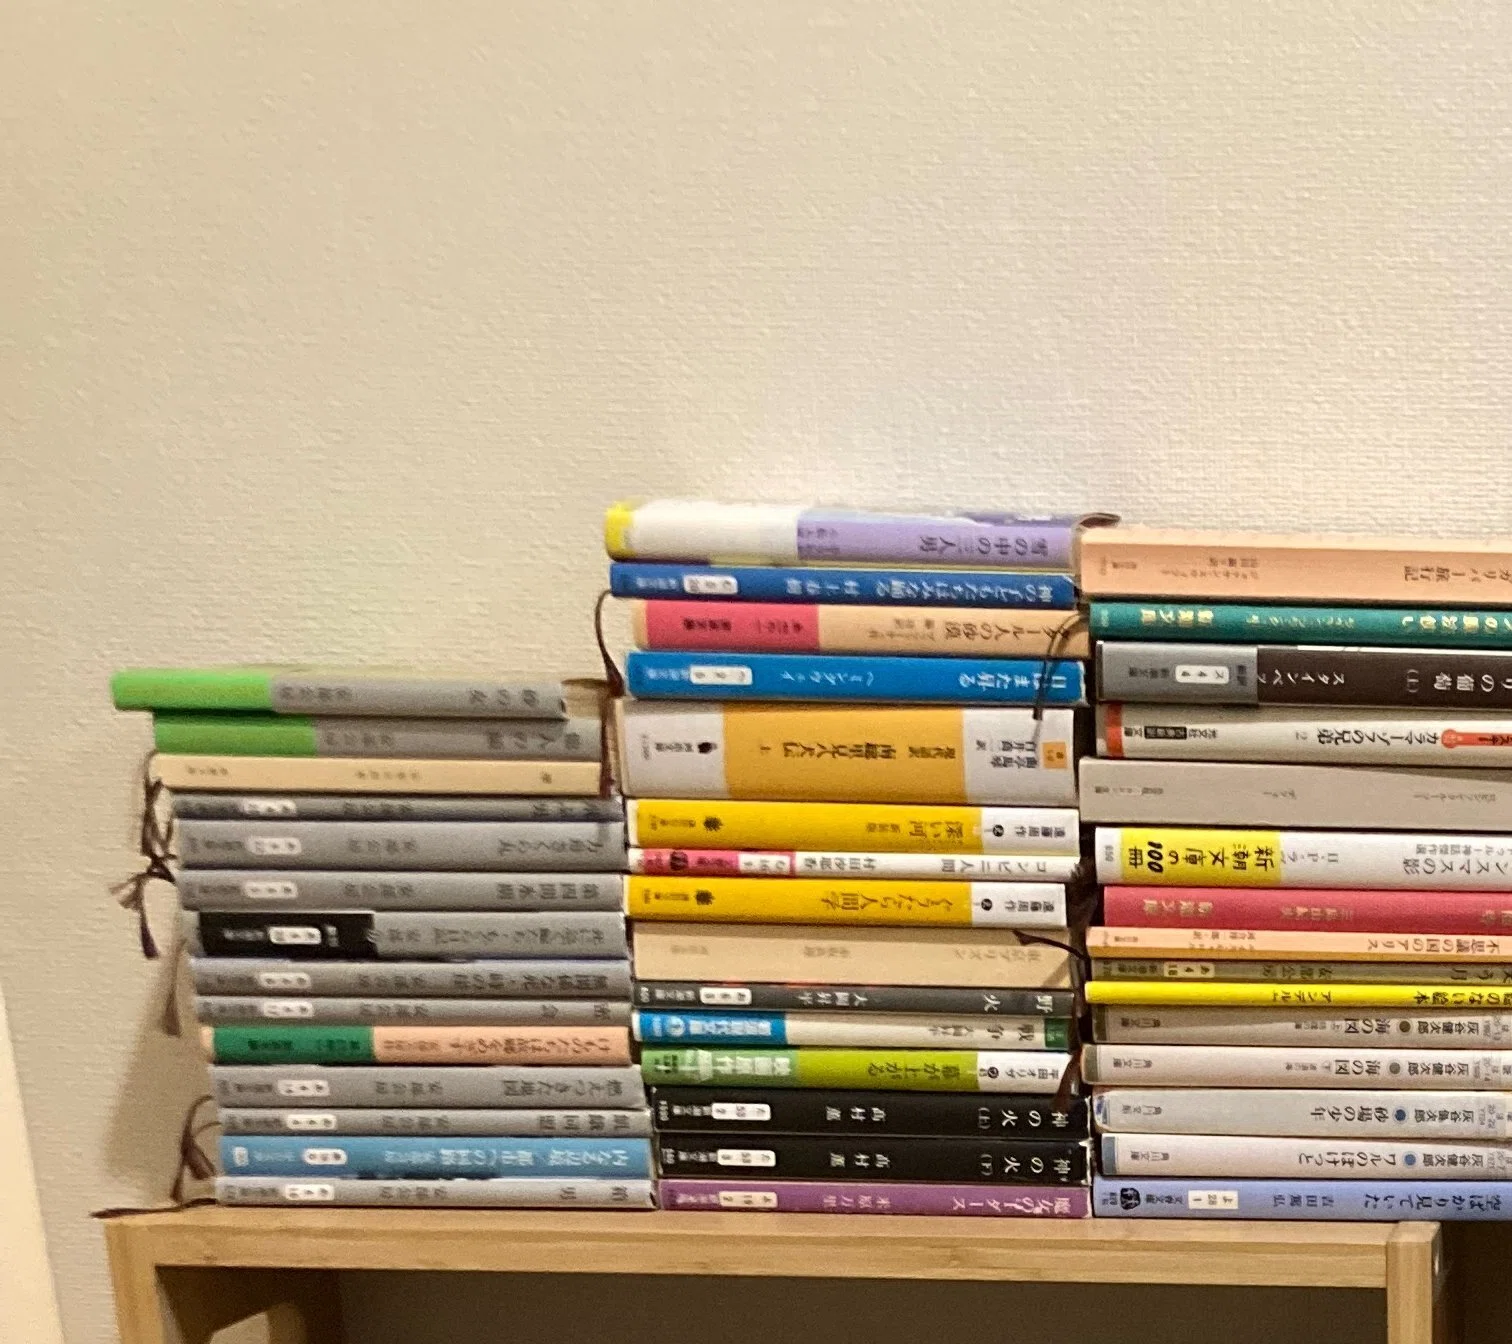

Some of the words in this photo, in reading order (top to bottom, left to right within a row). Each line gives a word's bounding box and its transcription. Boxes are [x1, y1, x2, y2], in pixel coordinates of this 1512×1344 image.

[1316, 728, 1440, 746] カラマーゾフの兄弟
[908, 820, 964, 839] 深い河
[941, 858, 1049, 875] コンビニ人間
[819, 893, 956, 913] ぐうたら人間学
[1365, 936, 1501, 954] 不思議の国のアリス
[982, 994, 1054, 1015] 野火
[503, 1078, 625, 1098] 燃えつきた地図
[999, 1108, 1071, 1128] 神の火
[1002, 1156, 1072, 1175] 神の火
[1361, 1191, 1503, 1211] 空ばかり見ていた
